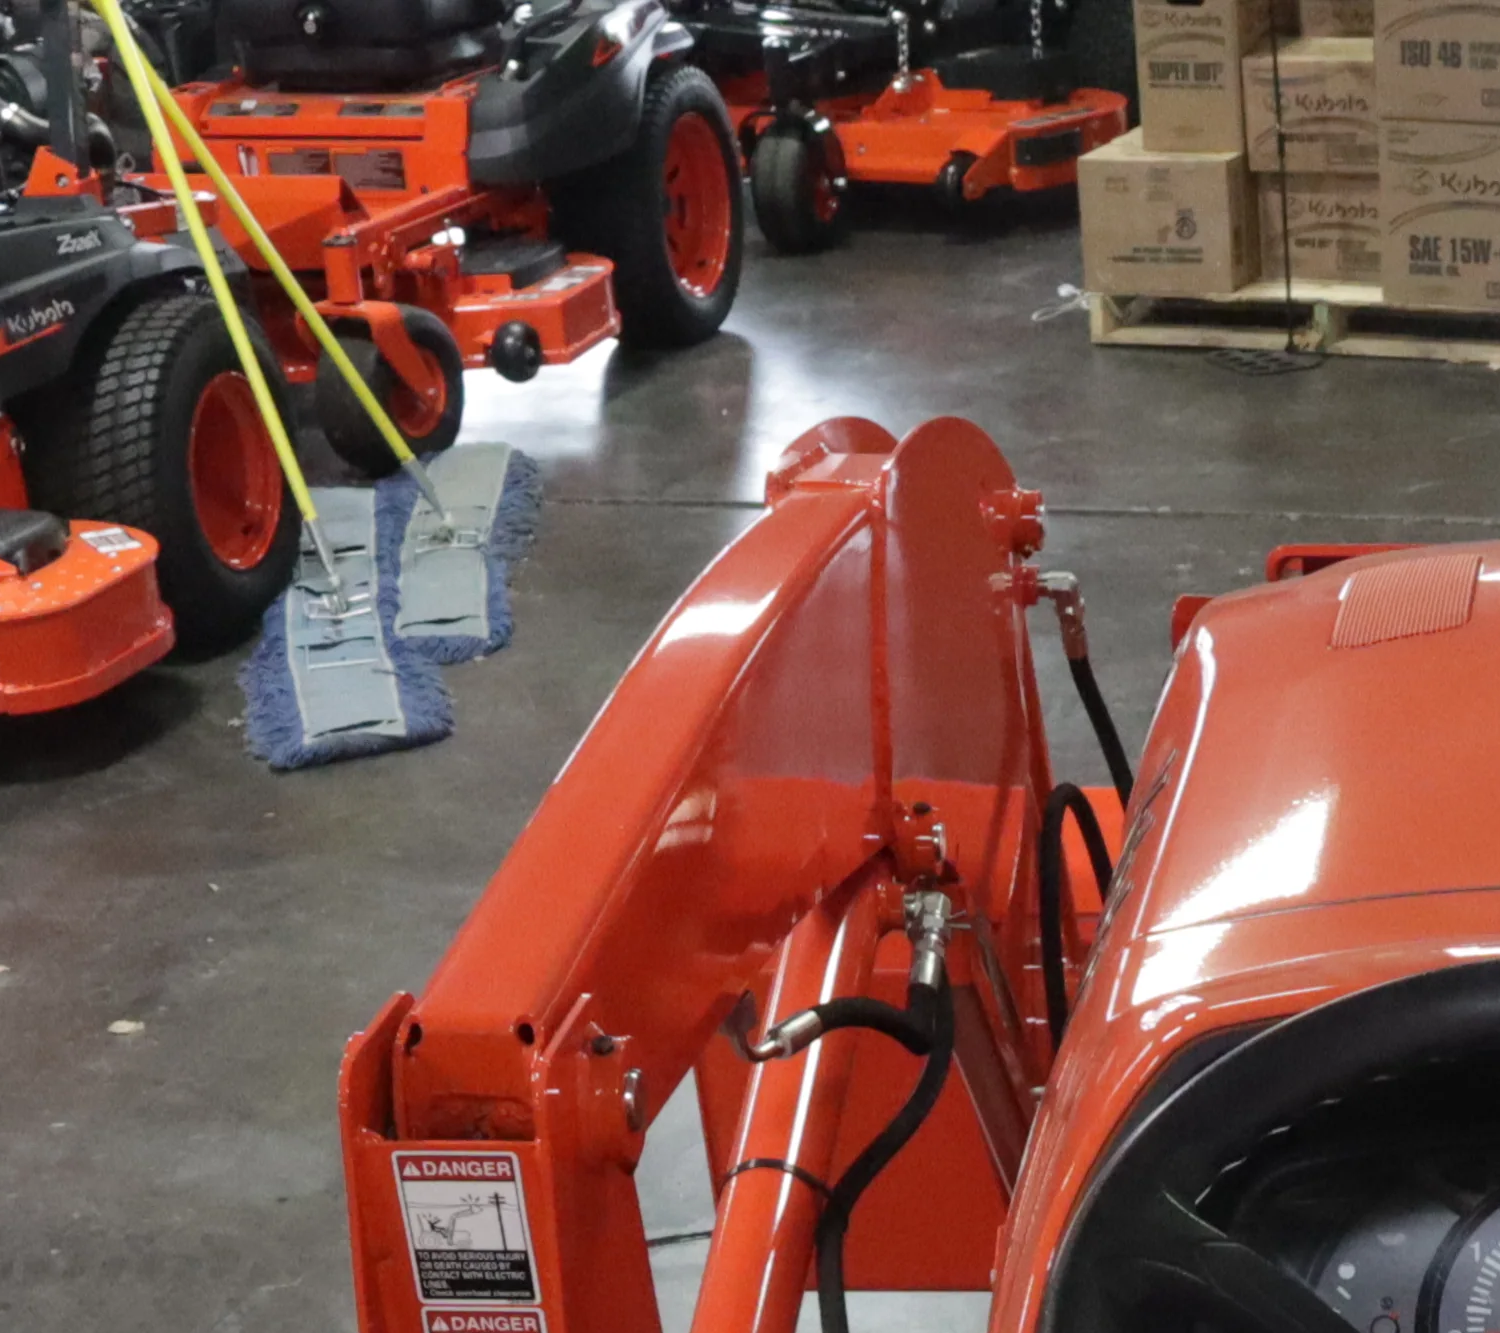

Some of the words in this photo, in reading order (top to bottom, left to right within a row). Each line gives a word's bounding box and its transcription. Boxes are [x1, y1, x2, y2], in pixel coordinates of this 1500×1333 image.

[1296, 93, 1369, 112] Kubota
[1308, 199, 1379, 219] Kubota
[1409, 234, 1442, 262] SAE
[6, 297, 76, 334] Kubota
[422, 1161, 512, 1177] DANGER
[1469, 1241, 1481, 1263] 1
[450, 1314, 538, 1333] DANGER
